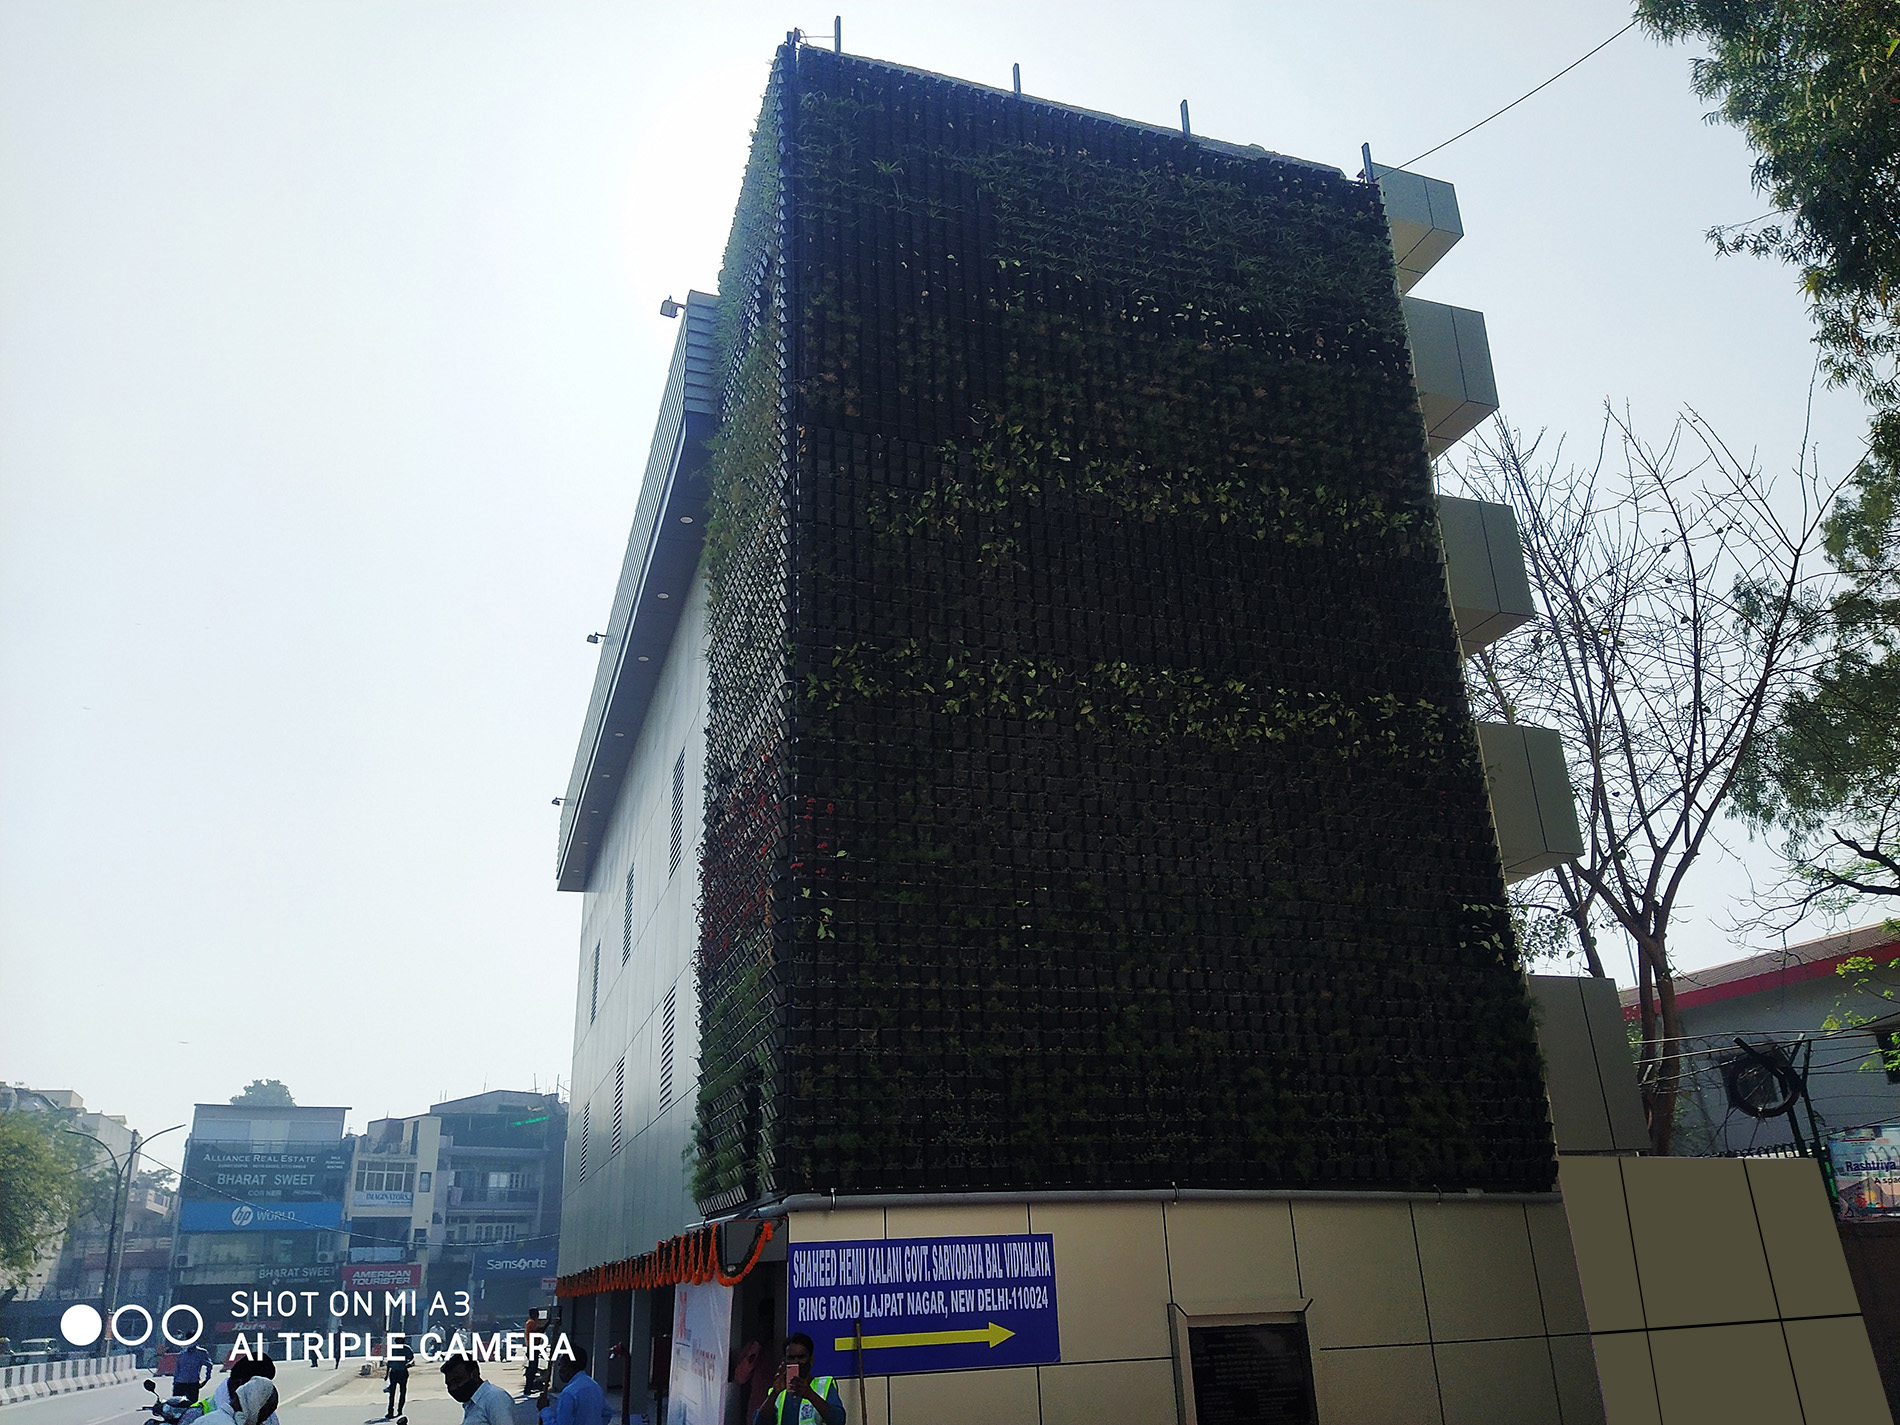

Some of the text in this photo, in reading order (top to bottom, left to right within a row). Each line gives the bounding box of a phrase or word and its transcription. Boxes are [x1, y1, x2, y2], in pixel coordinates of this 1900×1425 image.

[203, 1153, 250, 1162] ALLIANCE
[253, 1154, 279, 1163] REAL
[280, 1154, 316, 1163] ESTATE
[1845, 1160, 1896, 1172] Rashtriya
[217, 1173, 315, 1186] BHARAT SWEET
[247, 1189, 282, 1197] CORNER
[232, 1205, 295, 1226] hp WORLD
[486, 1258, 547, 1271] Samsonite
[793, 1241, 1051, 1288] SHAHEED HEMU KALANI GOVT. SARVODAYA BAL VIDYALAYA
[259, 1266, 335, 1279] BHARAT SWEET
[352, 1269, 411, 1278] AMERICAN
[352, 1277, 411, 1286] TOURISTER
[798, 1285, 1048, 1322] RING ROAD LAJPAT NAGAR, NEW DELHI-110024
